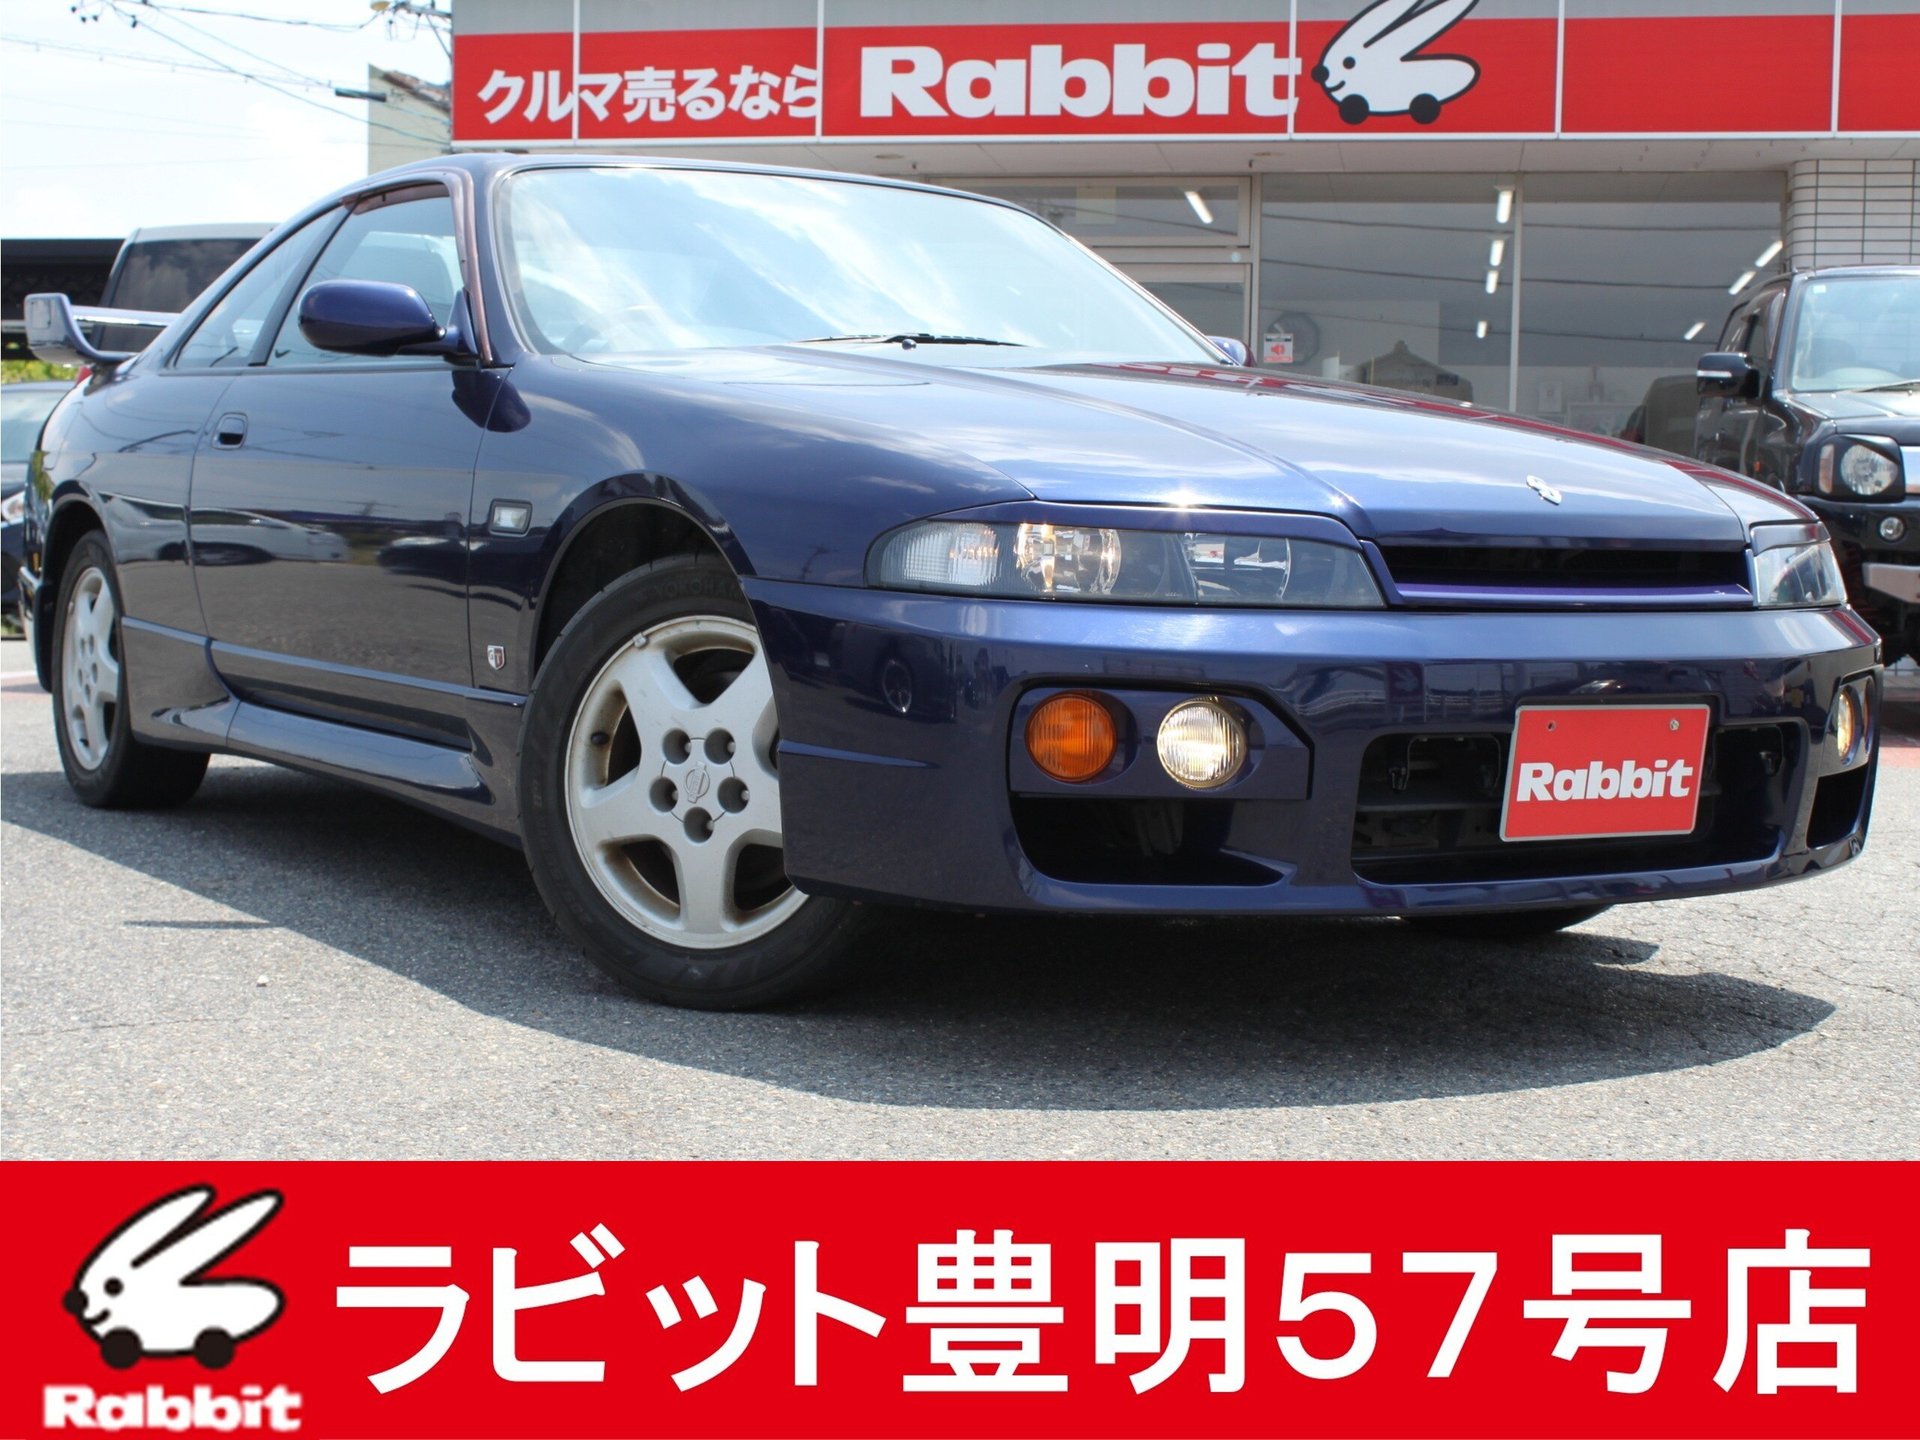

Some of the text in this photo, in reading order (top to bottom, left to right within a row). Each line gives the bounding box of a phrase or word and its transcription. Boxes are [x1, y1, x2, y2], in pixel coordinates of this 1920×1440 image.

[477, 64, 820, 125] クルマ売るなら
[860, 42, 1302, 118] Rabbit
[1516, 758, 1694, 802] Rabbit
